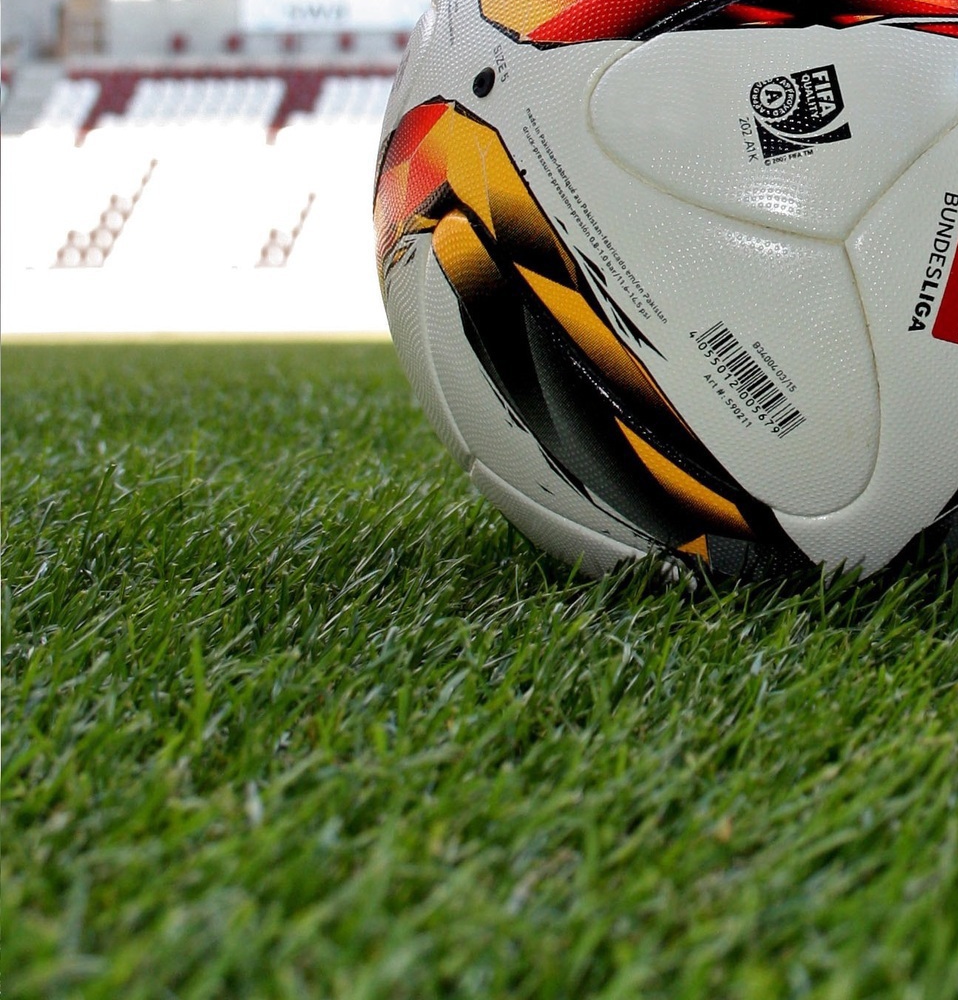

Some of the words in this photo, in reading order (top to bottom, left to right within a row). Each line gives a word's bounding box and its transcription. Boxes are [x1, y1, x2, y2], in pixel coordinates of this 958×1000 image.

[493, 44, 507, 73] SIZE
[500, 72, 509, 83] 5
[765, 89, 782, 105] A
[801, 73, 820, 119] QUALITY
[812, 70, 837, 118] FIFA
[788, 151, 803, 160] FIFA
[573, 193, 583, 204] au
[642, 292, 668, 324] Pakistan
[638, 307, 651, 320] psi
[703, 373, 718, 388] Art
[752, 341, 779, 371] B34004
[776, 370, 798, 393] 03/15
